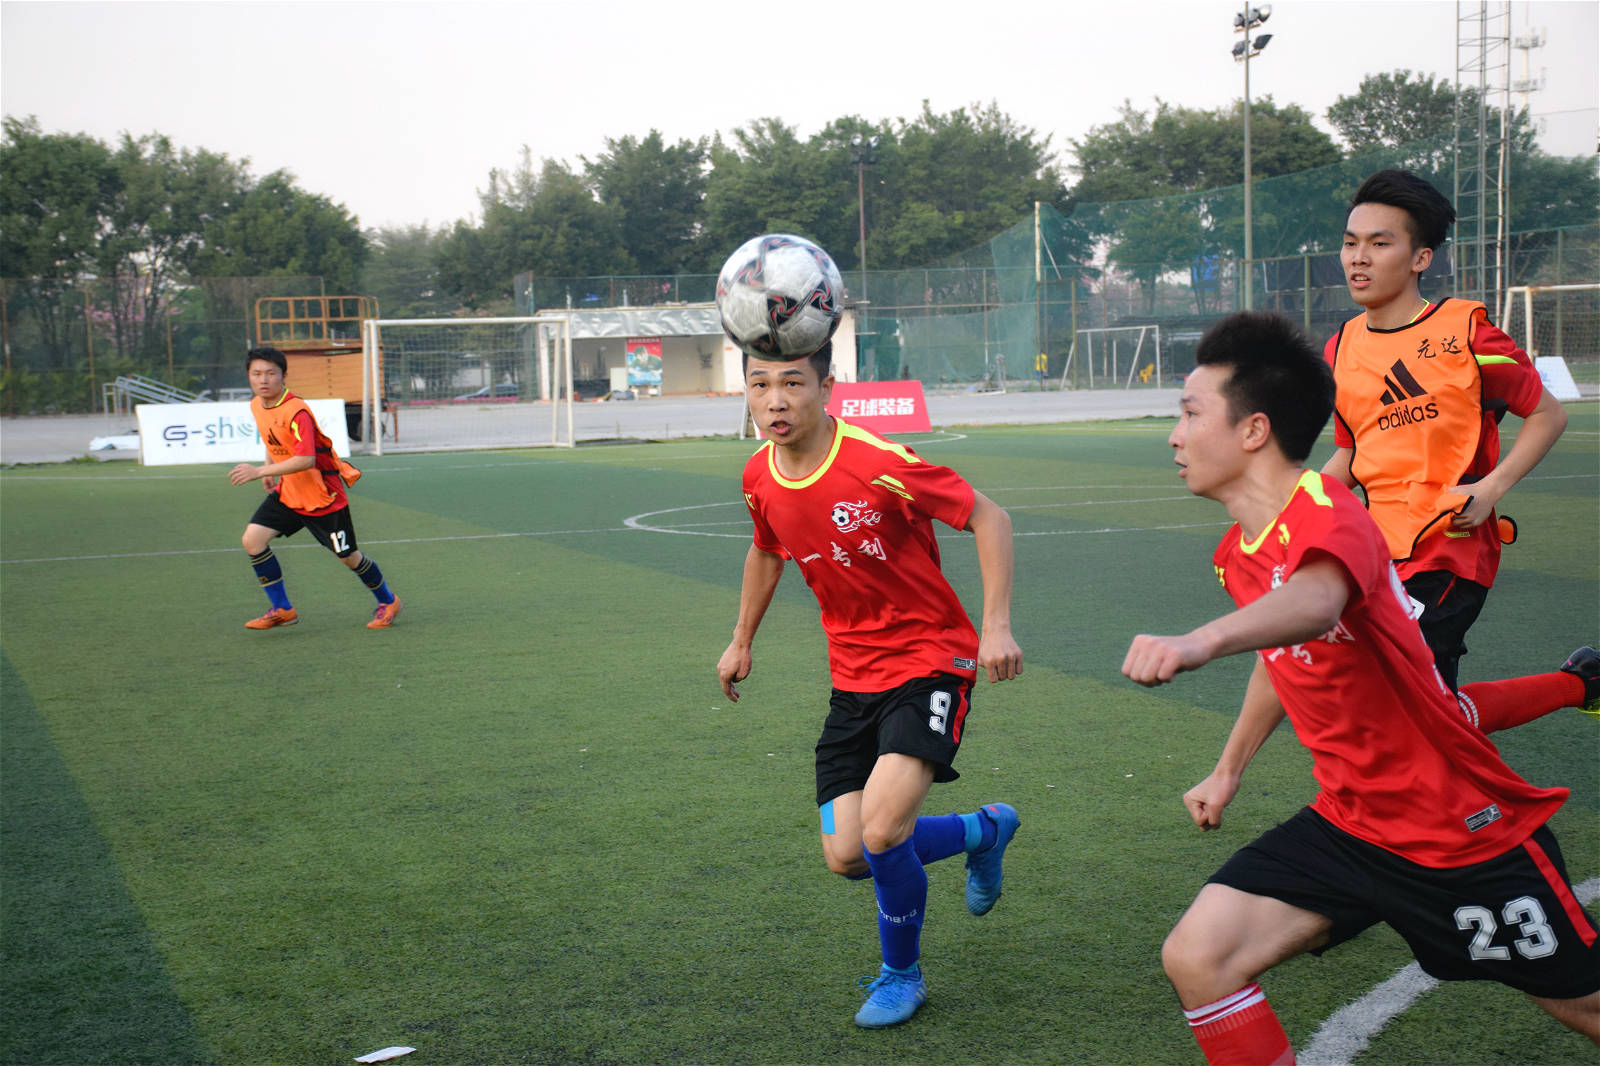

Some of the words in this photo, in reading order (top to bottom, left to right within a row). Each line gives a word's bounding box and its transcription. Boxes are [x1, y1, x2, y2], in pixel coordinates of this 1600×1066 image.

[841, 398, 915, 417] 足球装备
[1377, 402, 1439, 431] adidas
[330, 530, 350, 553] 12
[929, 690, 951, 735] 9
[1453, 895, 1559, 961] 23
